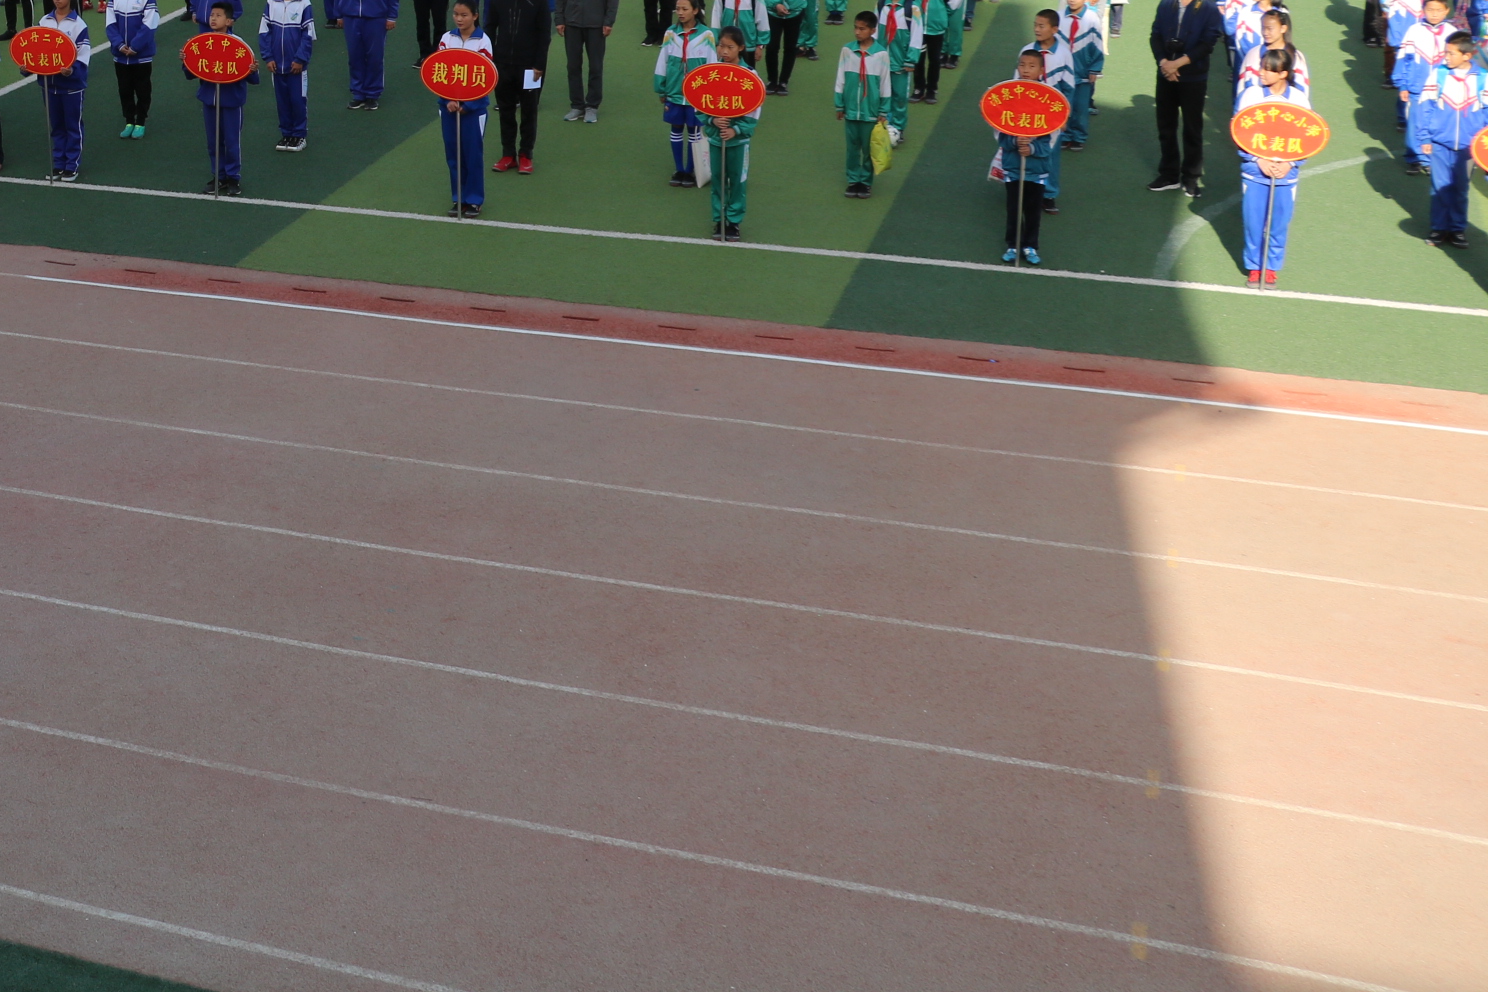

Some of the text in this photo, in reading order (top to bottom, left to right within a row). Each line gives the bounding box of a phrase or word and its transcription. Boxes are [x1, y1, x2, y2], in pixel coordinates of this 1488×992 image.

[19, 31, 64, 48] 山丹二中
[190, 37, 246, 58] 育才中学
[23, 53, 64, 66] 代表队
[198, 59, 238, 74] 代表队
[432, 62, 486, 88] 裁判员
[691, 70, 754, 91] 城关小学
[701, 94, 745, 109] 代表队
[988, 85, 1064, 112] 清泉中心小学
[1000, 111, 1047, 128] 代表队
[1240, 107, 1322, 137] 位奇中心小学
[1251, 133, 1303, 153] 代表队
